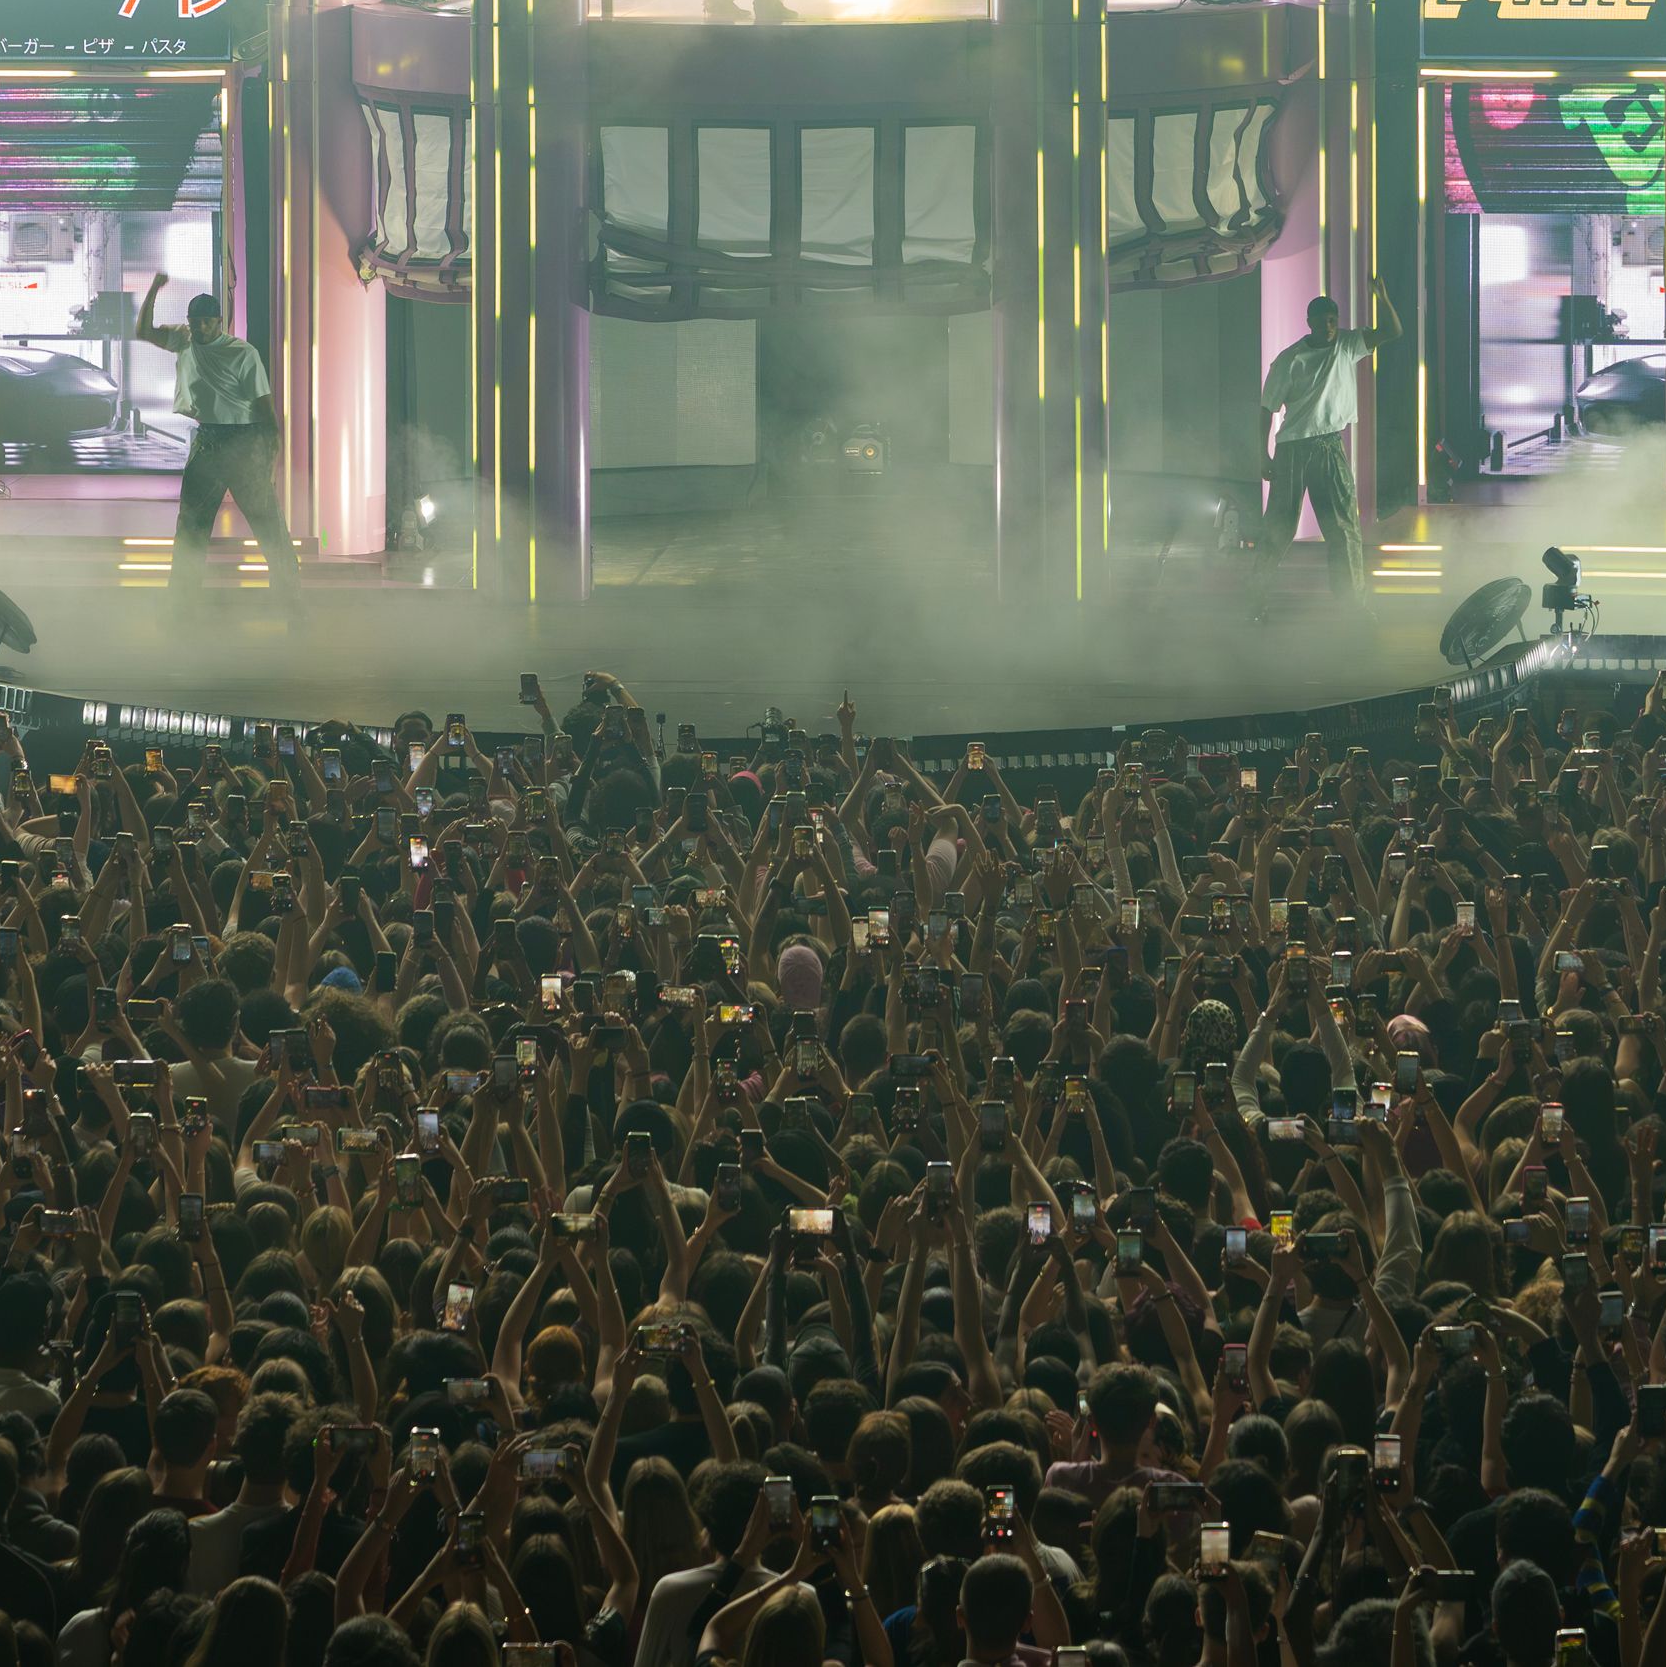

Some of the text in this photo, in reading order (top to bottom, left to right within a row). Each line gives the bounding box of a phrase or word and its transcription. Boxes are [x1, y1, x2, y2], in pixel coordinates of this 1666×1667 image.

[84, 38, 114, 54] ピザ
[142, 38, 185, 54] パスタ
